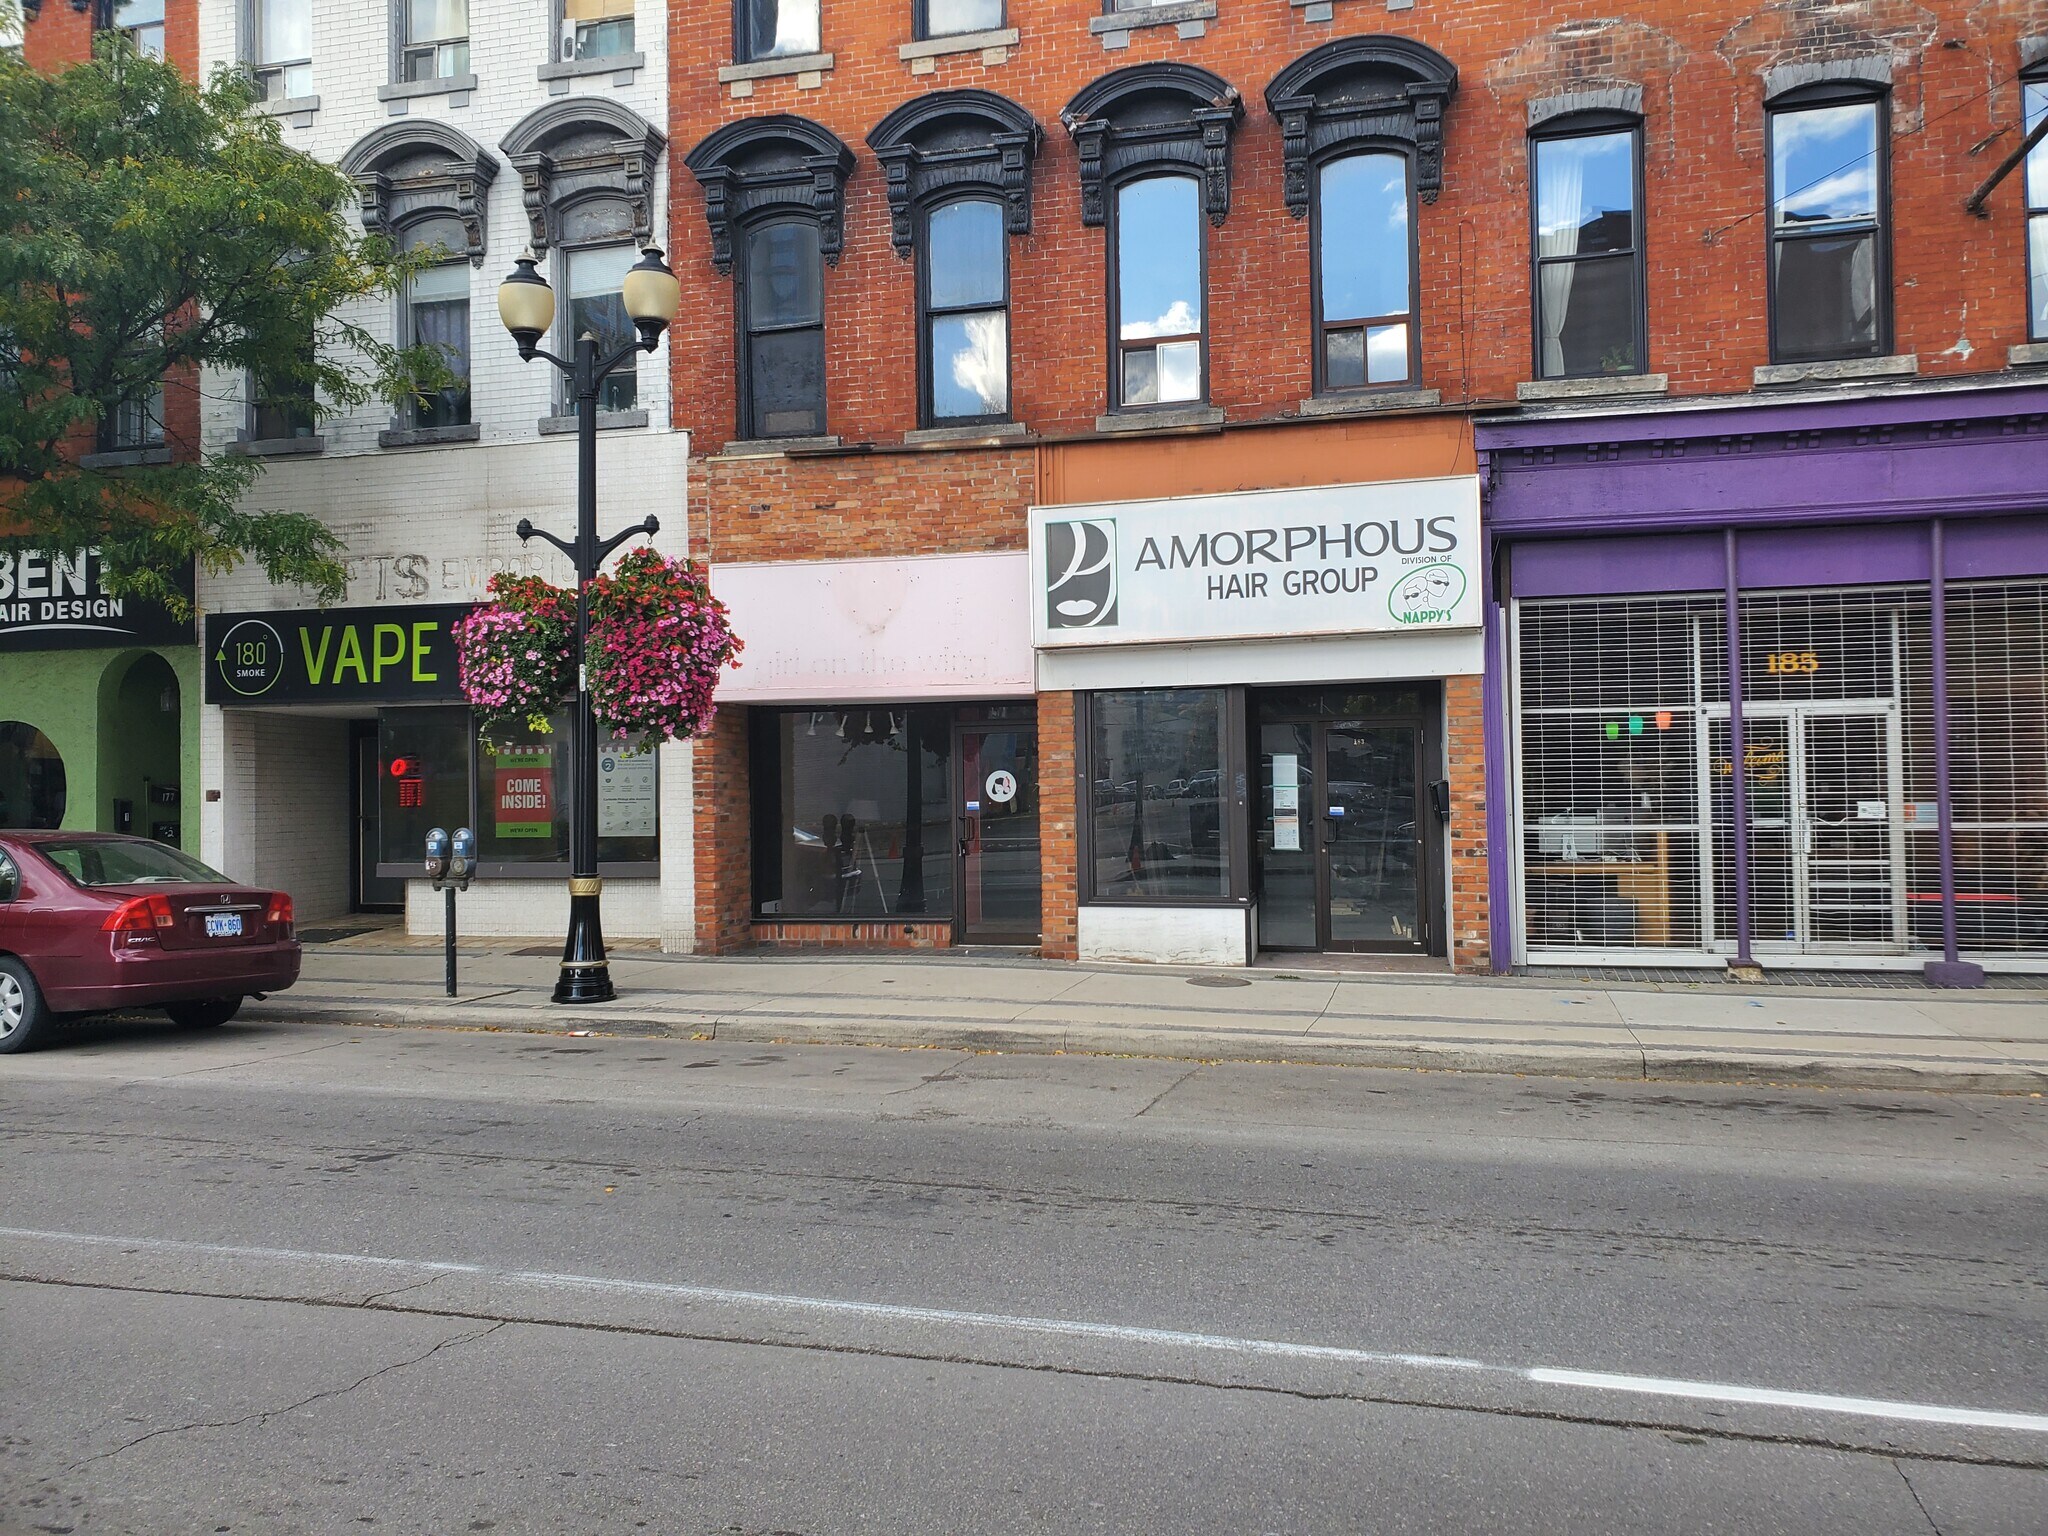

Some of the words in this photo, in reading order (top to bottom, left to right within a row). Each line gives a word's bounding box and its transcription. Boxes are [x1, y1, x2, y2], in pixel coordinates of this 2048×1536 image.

[1134, 516, 1458, 571] AMORPHOUS
[1401, 556, 1437, 565] DIVISION
[1440, 554, 1453, 563] OF
[0, 546, 123, 600] EN
[1207, 572, 1268, 601] HAIR
[1282, 566, 1378, 596] GROUP
[41, 599, 123, 620] DESIGN
[1402, 609, 1452, 624] NAPPY'S
[299, 621, 439, 685] VAPE
[1765, 652, 1819, 674] 185
[236, 668, 266, 678] SMOKE
[506, 778, 541, 793] COME
[162, 792, 175, 802] 177
[501, 794, 546, 809] INSIDE!
